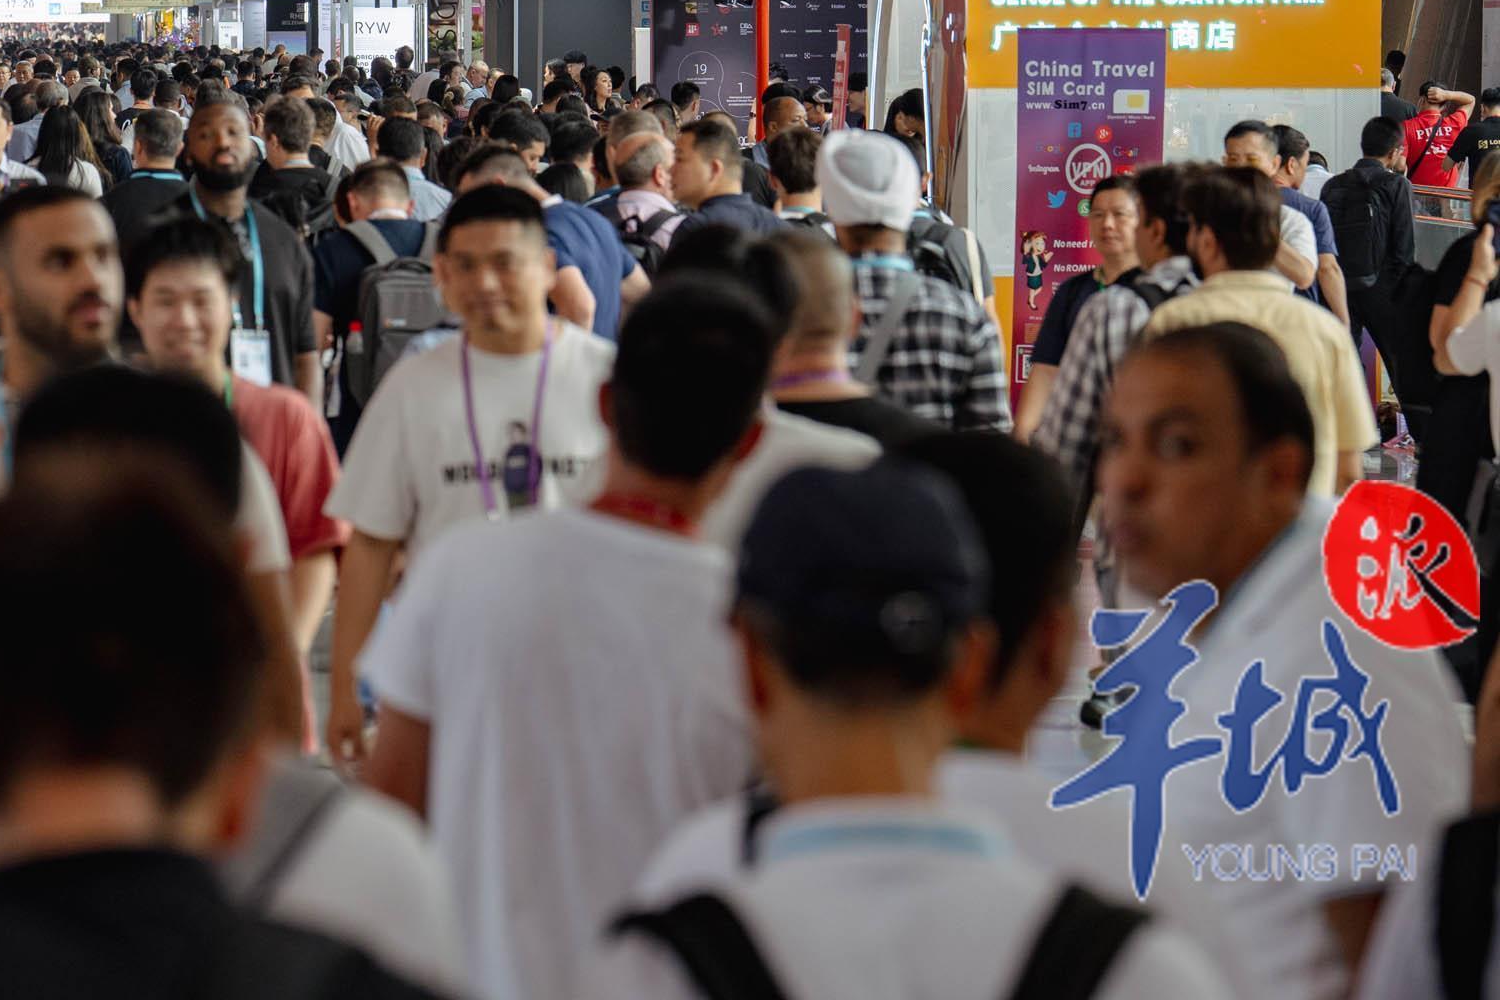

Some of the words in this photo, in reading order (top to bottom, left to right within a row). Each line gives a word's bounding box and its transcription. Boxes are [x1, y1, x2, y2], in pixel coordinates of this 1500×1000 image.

[355, 21, 391, 34] RYW
[694, 63, 707, 75] 19
[1025, 60, 1083, 78] China
[1092, 60, 1155, 78] Travel
[737, 83, 743, 93] 1
[1026, 82, 1054, 96] SIM
[1063, 82, 1105, 96] Card
[1026, 99, 1105, 111] www.Sim7.cn
[1072, 162, 1104, 178] VPN
[1053, 239, 1065, 248] No
[1066, 239, 1088, 248] need
[1053, 264, 1065, 272] No
